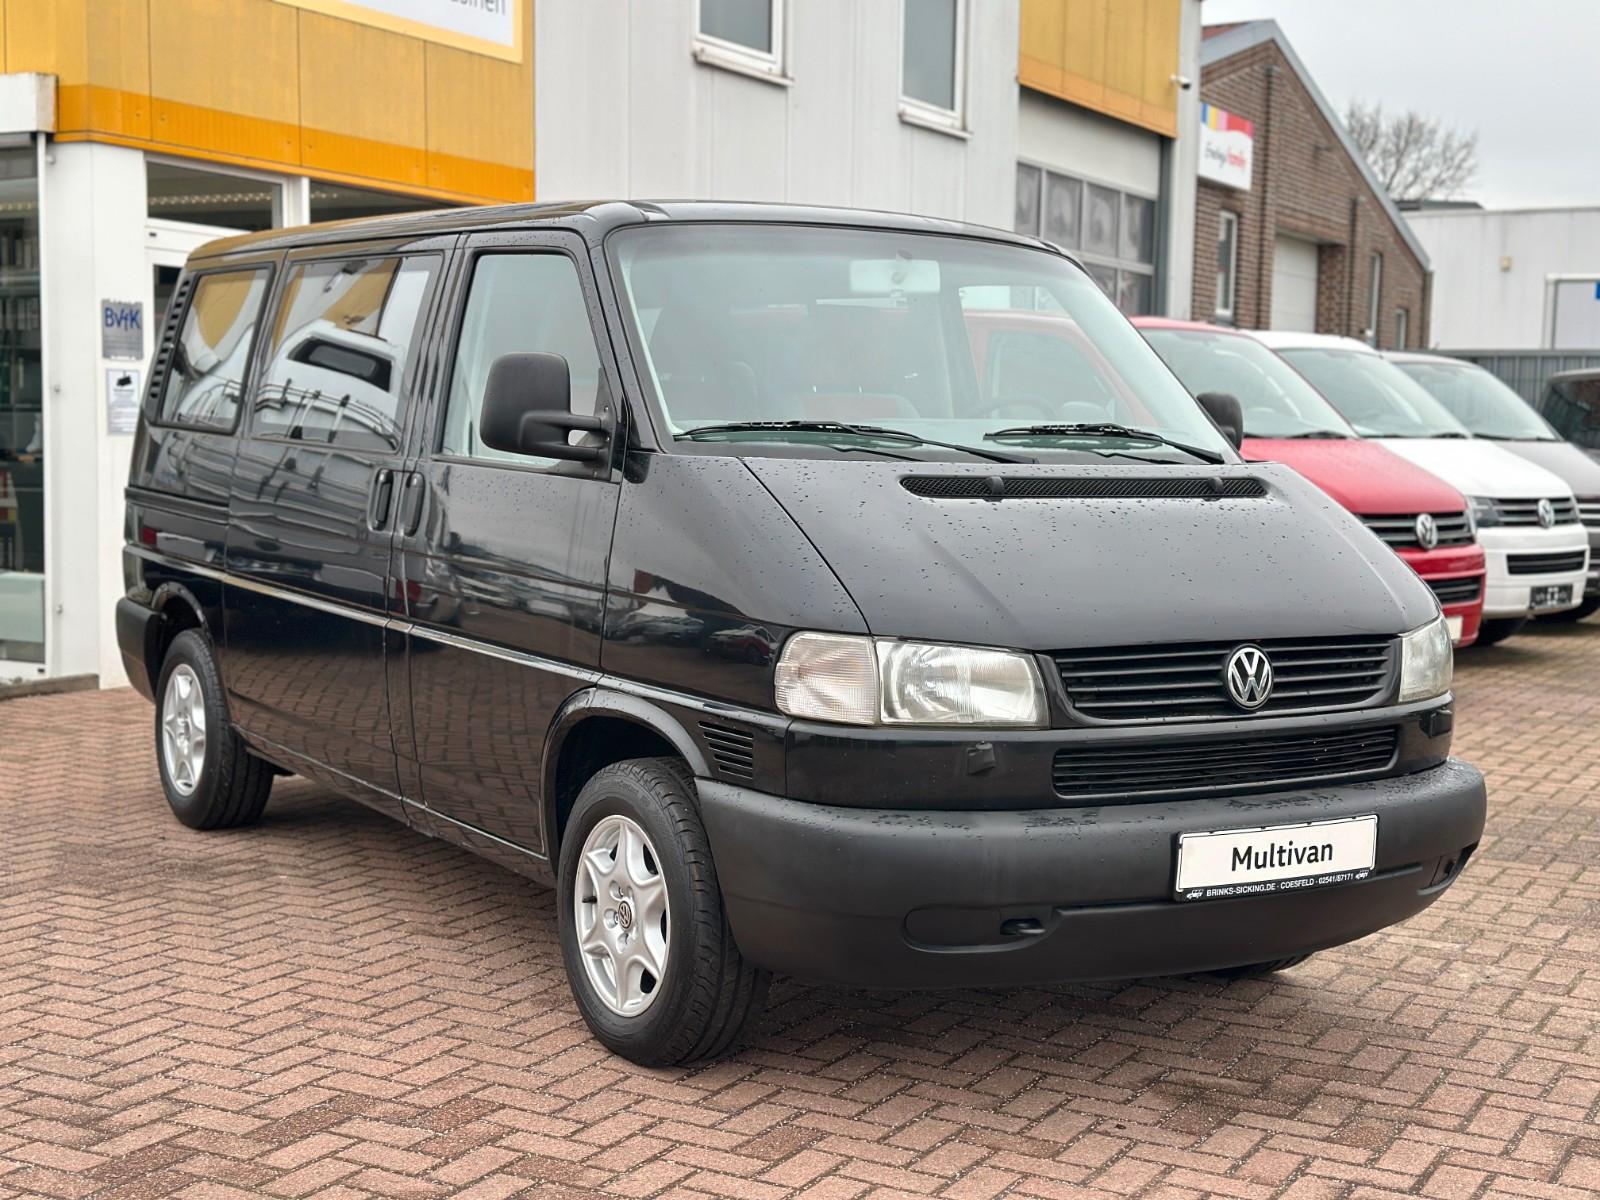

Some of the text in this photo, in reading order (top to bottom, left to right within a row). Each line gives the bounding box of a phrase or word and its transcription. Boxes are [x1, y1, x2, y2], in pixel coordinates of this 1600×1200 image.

[1227, 647, 1272, 707] VW
[1231, 840, 1334, 872] Multivan
[1206, 882, 1276, 897] BRINKS-SICKING.DE
[1280, 878, 1315, 890] COESFELD
